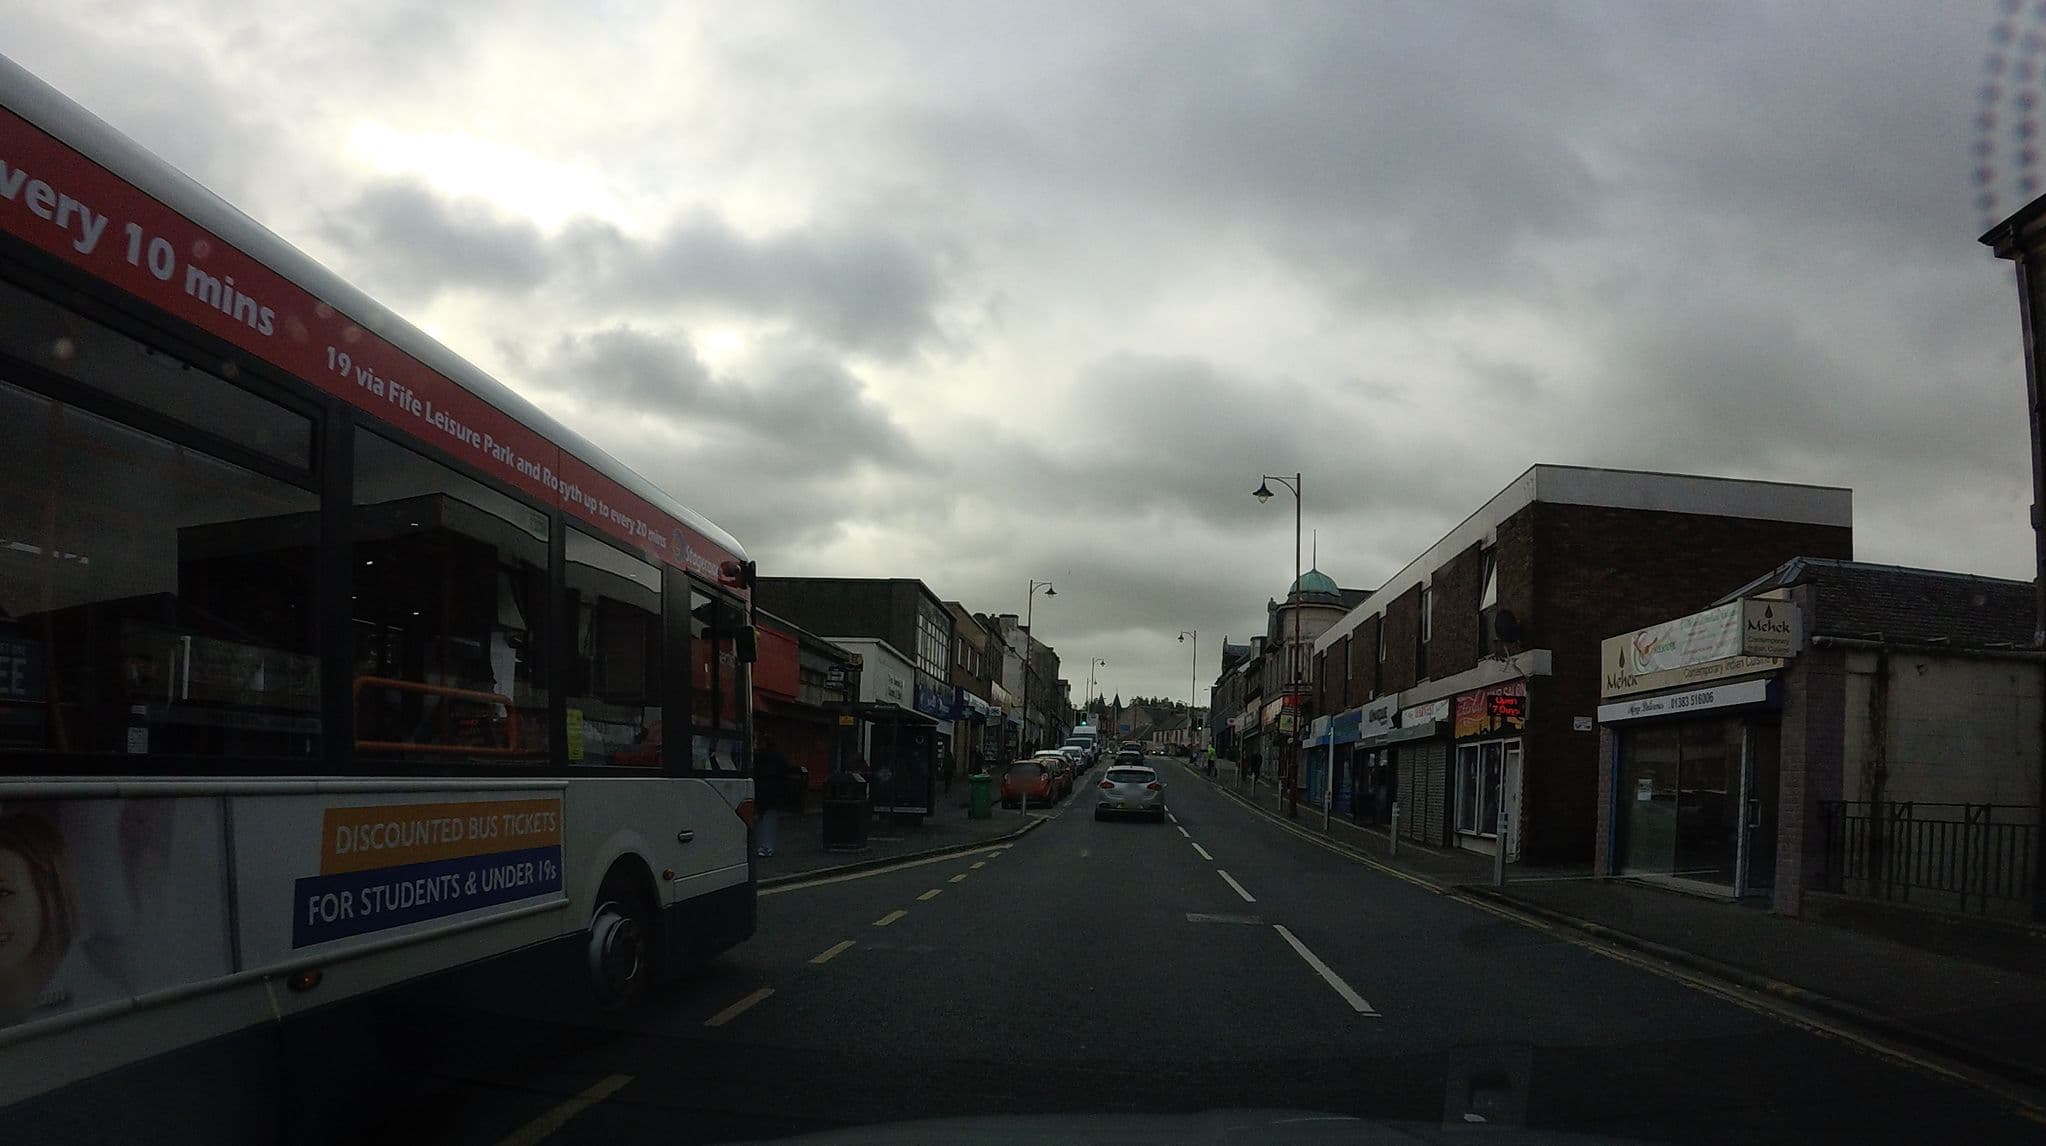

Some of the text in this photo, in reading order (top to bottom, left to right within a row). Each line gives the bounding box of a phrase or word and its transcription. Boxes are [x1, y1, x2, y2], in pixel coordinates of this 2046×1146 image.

[124, 222, 175, 281] 10
[184, 263, 276, 337] mins
[327, 345, 667, 548] 19 via Fife Leisure Park and Rosyth up to every 20 mins
[1747, 619, 1790, 634] Mehek
[1670, 695, 1689, 709] 01383
[1690, 691, 1714, 706] 516006
[335, 811, 556, 856] DISCOUNTED BUS TICKETS
[307, 859, 558, 926] FOR STUDENTS & UNDER 19s
